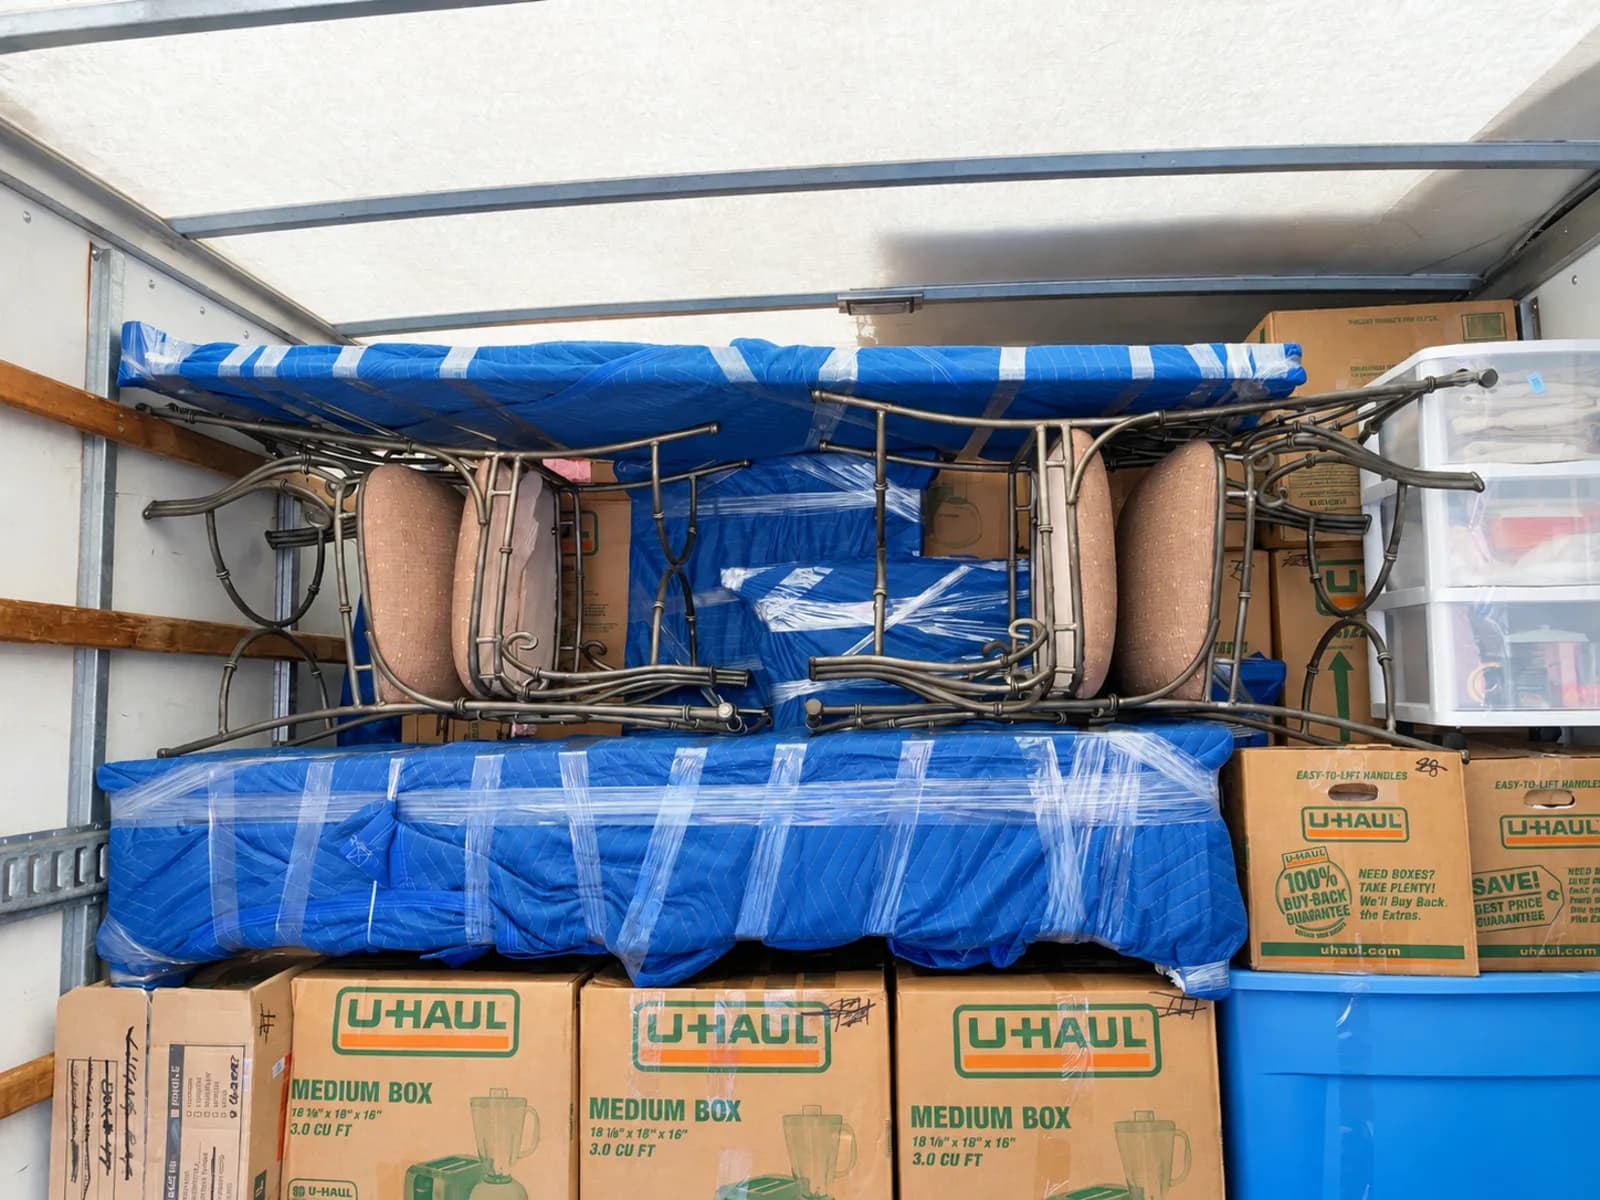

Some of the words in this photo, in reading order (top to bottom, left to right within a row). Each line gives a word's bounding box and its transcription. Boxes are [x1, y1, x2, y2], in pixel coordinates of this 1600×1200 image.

[1296, 770, 1360, 780] EASY-TO-LIFT
[1363, 771, 1408, 780] HANDLES
[1495, 780, 1559, 789] EASY-TO-LIFT
[1309, 812, 1402, 828] U-HAUL
[1508, 820, 1599, 835] U-HAUL
[1285, 849, 1326, 864] U-HAUL
[1284, 866, 1337, 894] 100%
[1359, 869, 1388, 880] NEED
[1392, 870, 1435, 880] BOXES?
[1359, 882, 1387, 893] TAKE
[1390, 883, 1435, 894] PLENTY!
[1473, 871, 1540, 896] SAVE!
[1284, 888, 1347, 911] BUY-BACK
[1360, 895, 1388, 906] We'll
[1391, 897, 1412, 908] Buy
[1475, 901, 1504, 915] BEST
[1508, 897, 1543, 910] PRICE
[1360, 909, 1378, 920] the
[1382, 910, 1421, 921] Extras.
[1476, 910, 1545, 927] GUARANTEE
[1320, 945, 1400, 956] uhaul.com
[1520, 946, 1596, 957] uhaul.com
[348, 999, 507, 1030] U-HAUL
[647, 1014, 818, 1044] U-HAUL
[968, 1017, 1147, 1048] U-HAUL
[291, 1079, 380, 1102] MEDIUM
[389, 1082, 432, 1104] BOX
[590, 1097, 685, 1121] MEDIUM
[695, 1100, 741, 1122] BOX
[911, 1106, 1012, 1129] MEDIUM
[1022, 1106, 1071, 1129] BOX
[290, 1123, 310, 1135] 3.0
[314, 1124, 332, 1136] CU
[335, 1124, 352, 1136] FT
[589, 1143, 611, 1156] 3.0
[616, 1144, 633, 1157] CU
[637, 1144, 656, 1157] FT
[912, 1153, 935, 1166] 3.0
[940, 1153, 960, 1167] CU
[964, 1153, 982, 1167] FT
[308, 1186, 352, 1198] U-HAUL
